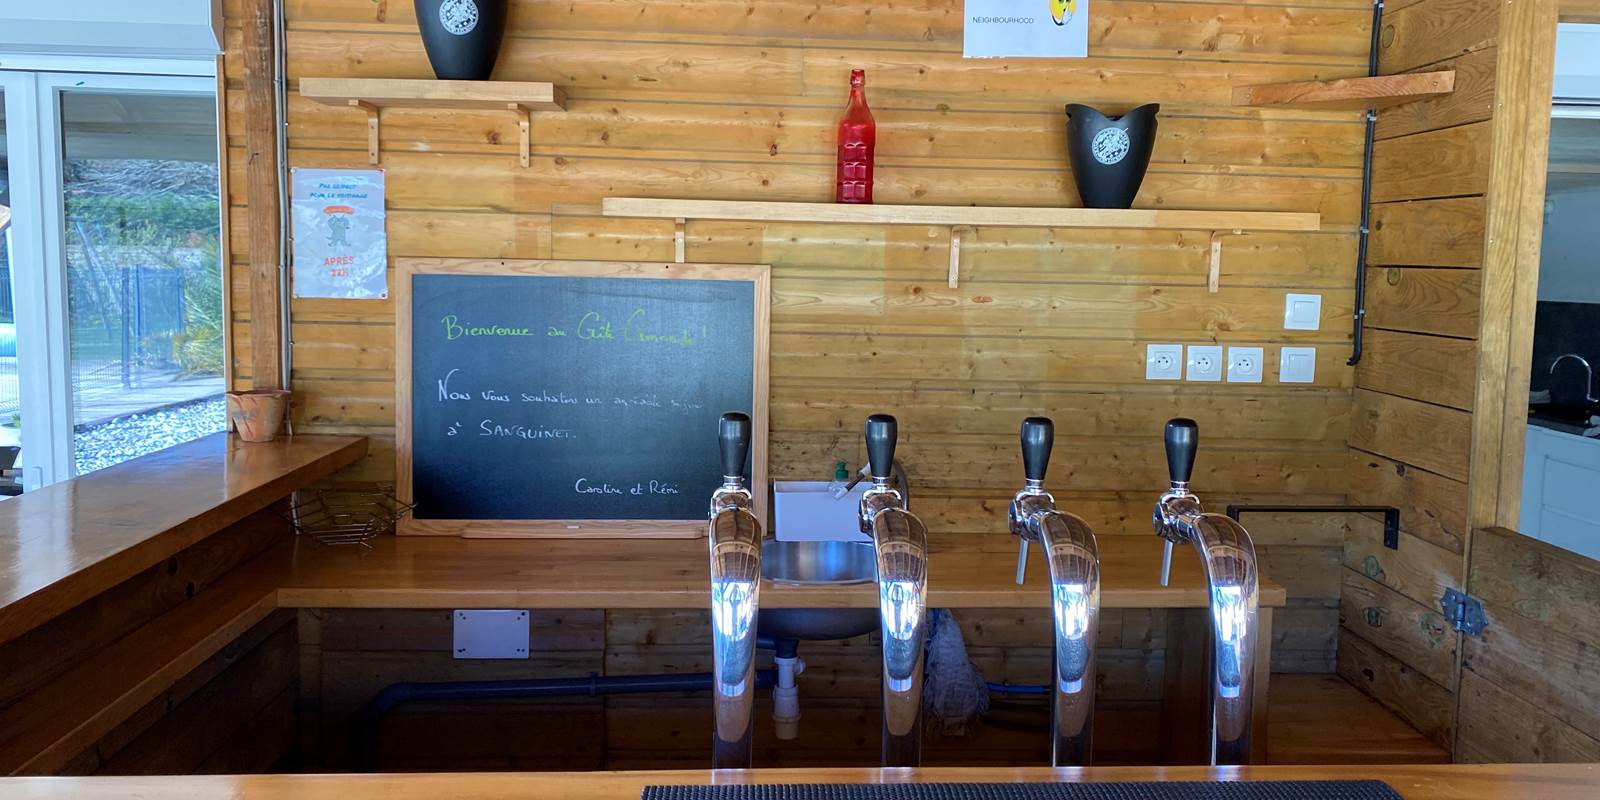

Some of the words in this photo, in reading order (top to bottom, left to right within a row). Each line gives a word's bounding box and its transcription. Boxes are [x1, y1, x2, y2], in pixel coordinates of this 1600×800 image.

[972, 16, 1034, 24] NEIGHBOURHOOD
[441, 315, 534, 340] Bienvenue
[438, 368, 471, 402] Nous
[575, 478, 623, 495] Caroline
[630, 483, 643, 496] et
[649, 480, 680, 495] Rémi
